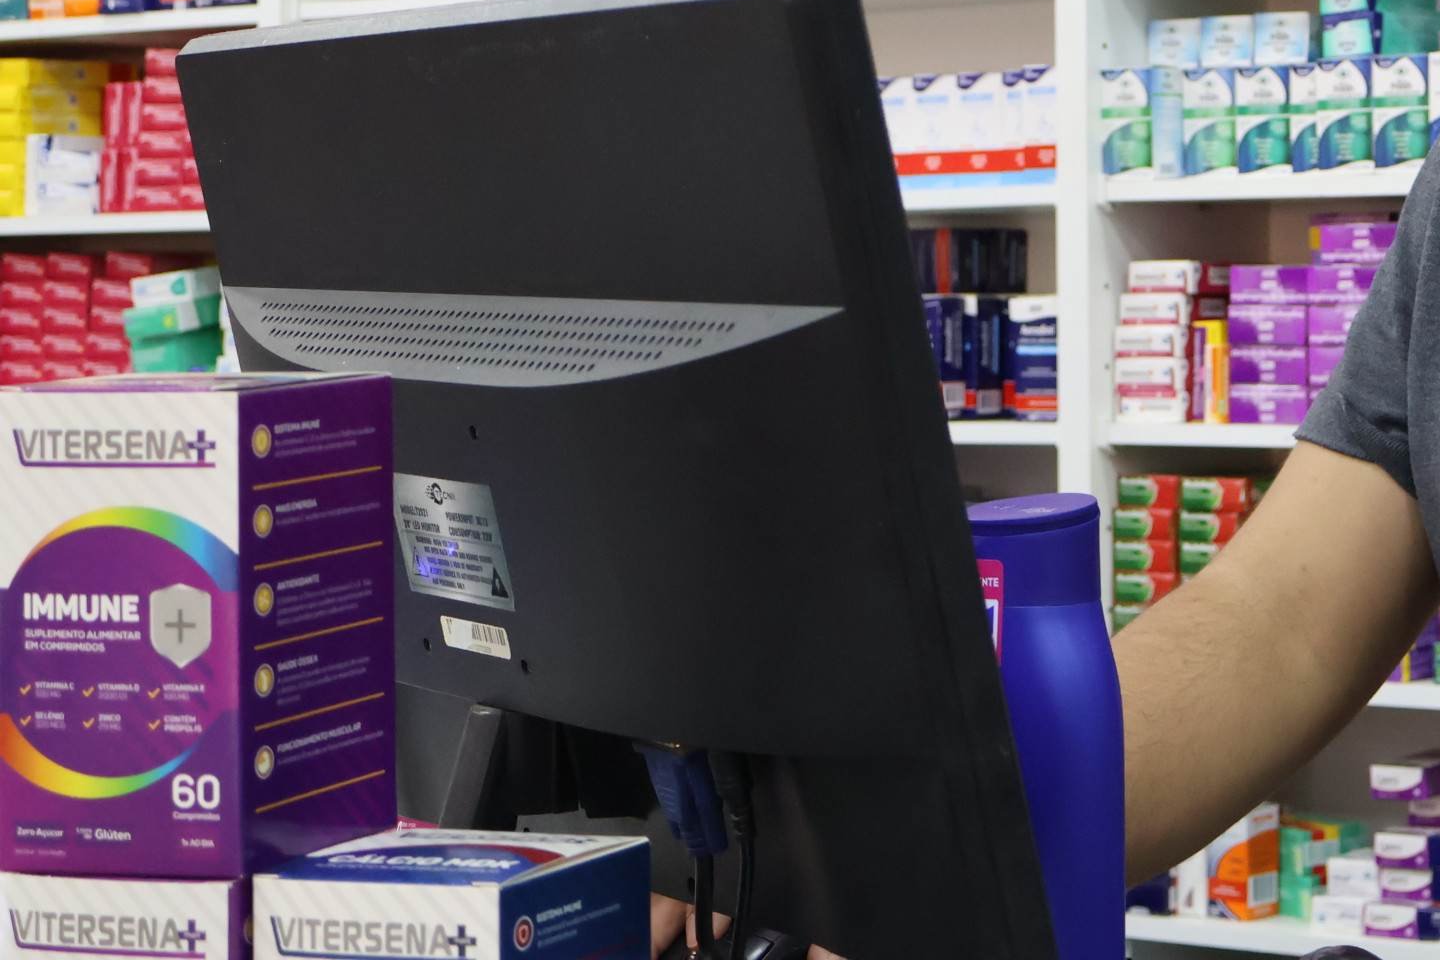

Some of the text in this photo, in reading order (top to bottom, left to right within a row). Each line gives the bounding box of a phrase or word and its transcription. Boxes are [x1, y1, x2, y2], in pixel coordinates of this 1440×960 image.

[980, 577, 999, 588] NTE
[23, 593, 139, 623] IMMUNE
[25, 628, 141, 640] SUPLEMENTO ALIMENTAR
[25, 641, 105, 652] EM COMPRIMIDOS
[35, 681, 66, 690] VITAMINA
[98, 683, 132, 692] VITAMINA
[163, 684, 197, 692] VITAMINA
[172, 774, 220, 809] 60
[172, 811, 220, 821] Comprimidos
[17, 826, 35, 836] Zero
[95, 828, 131, 840] Glúten
[328, 853, 441, 866] CÁLCIO
